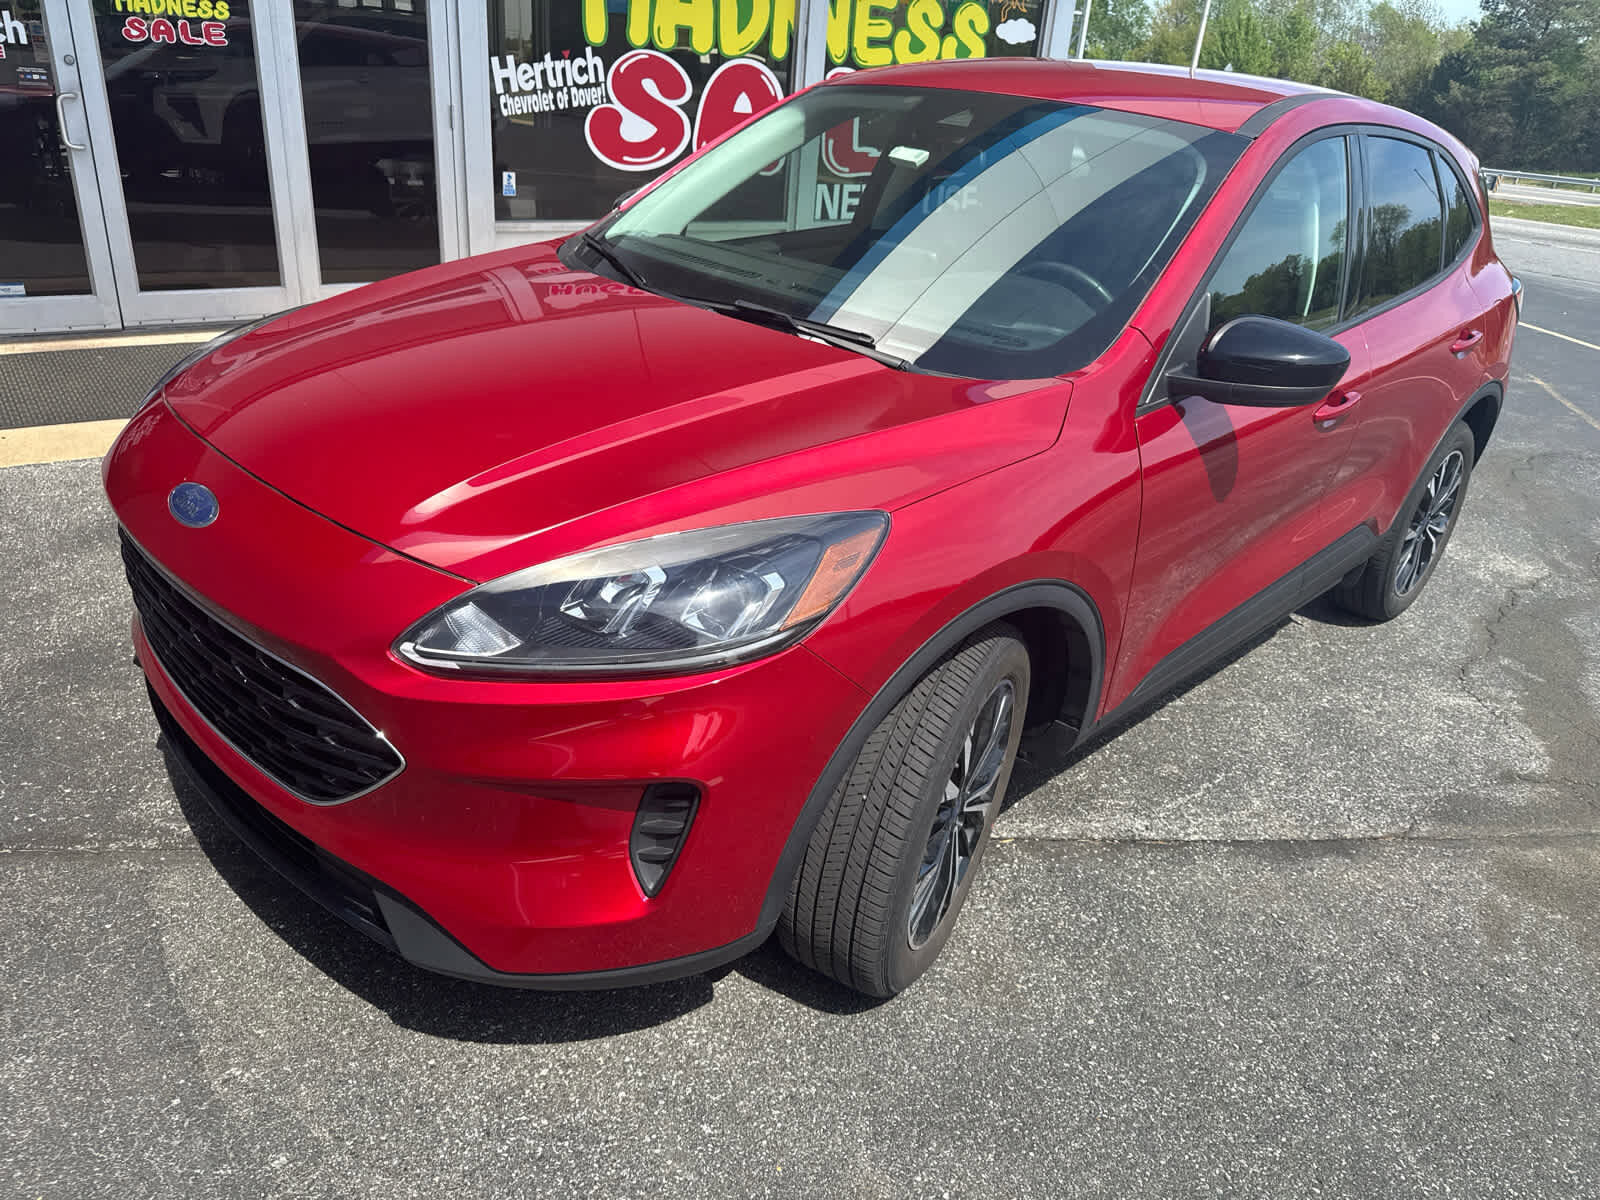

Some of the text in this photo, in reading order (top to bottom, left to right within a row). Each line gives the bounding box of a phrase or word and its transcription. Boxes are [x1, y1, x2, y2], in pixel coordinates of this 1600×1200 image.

[114, 0, 230, 20] MADNESS
[122, 16, 228, 46] SALE
[582, 0, 989, 69] MADNESS
[490, 46, 605, 95] Hertrich
[500, 82, 607, 117] Chevrolet of Dover!
[814, 183, 866, 221] NE
